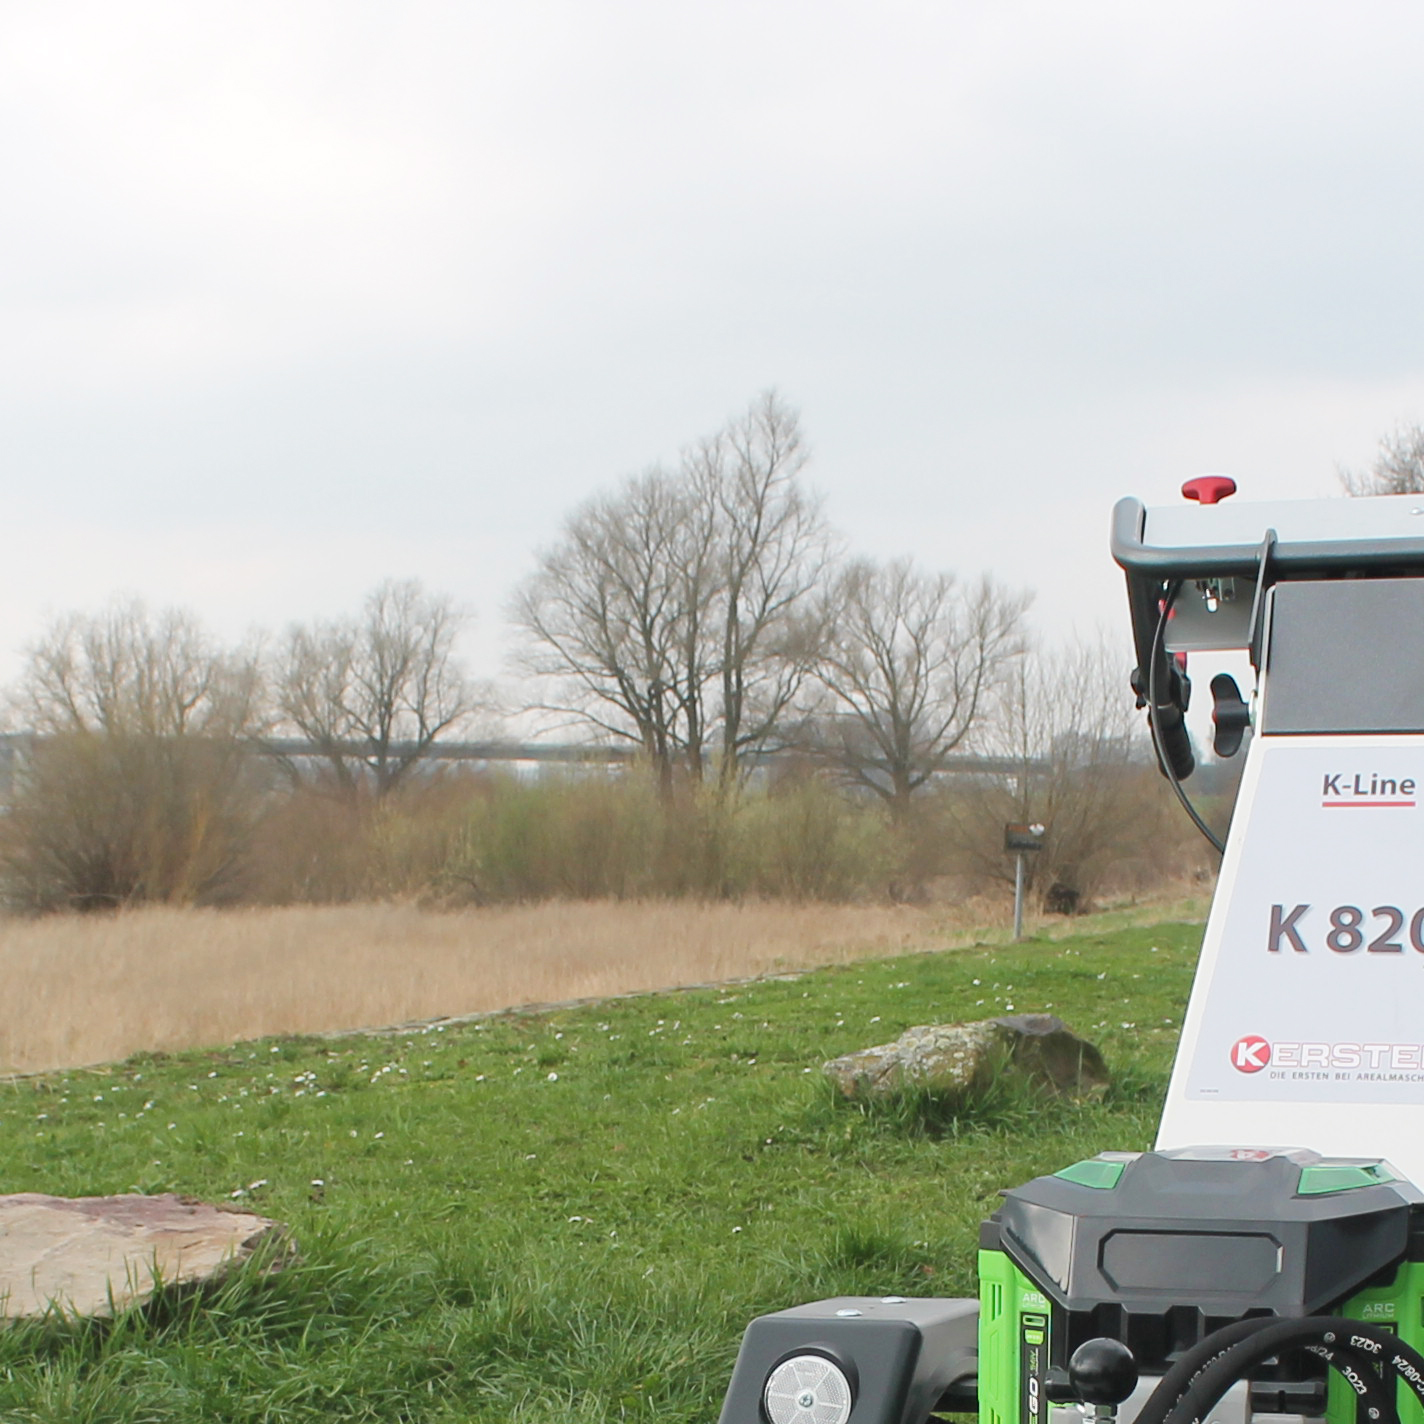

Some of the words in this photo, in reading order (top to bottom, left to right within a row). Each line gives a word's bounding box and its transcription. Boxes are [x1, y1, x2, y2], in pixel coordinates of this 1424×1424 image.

[1322, 773, 1416, 797] K-Line
[1267, 903, 1311, 954] K
[1269, 1071, 1286, 1080] DIE
[1292, 1072, 1329, 1081] ERSTEN
[1334, 1072, 1351, 1081] BEI
[1362, 1302, 1395, 1313] ARC
[1349, 1335, 1383, 1354] 3Q23
[1342, 1366, 1368, 1395] 3Q23
